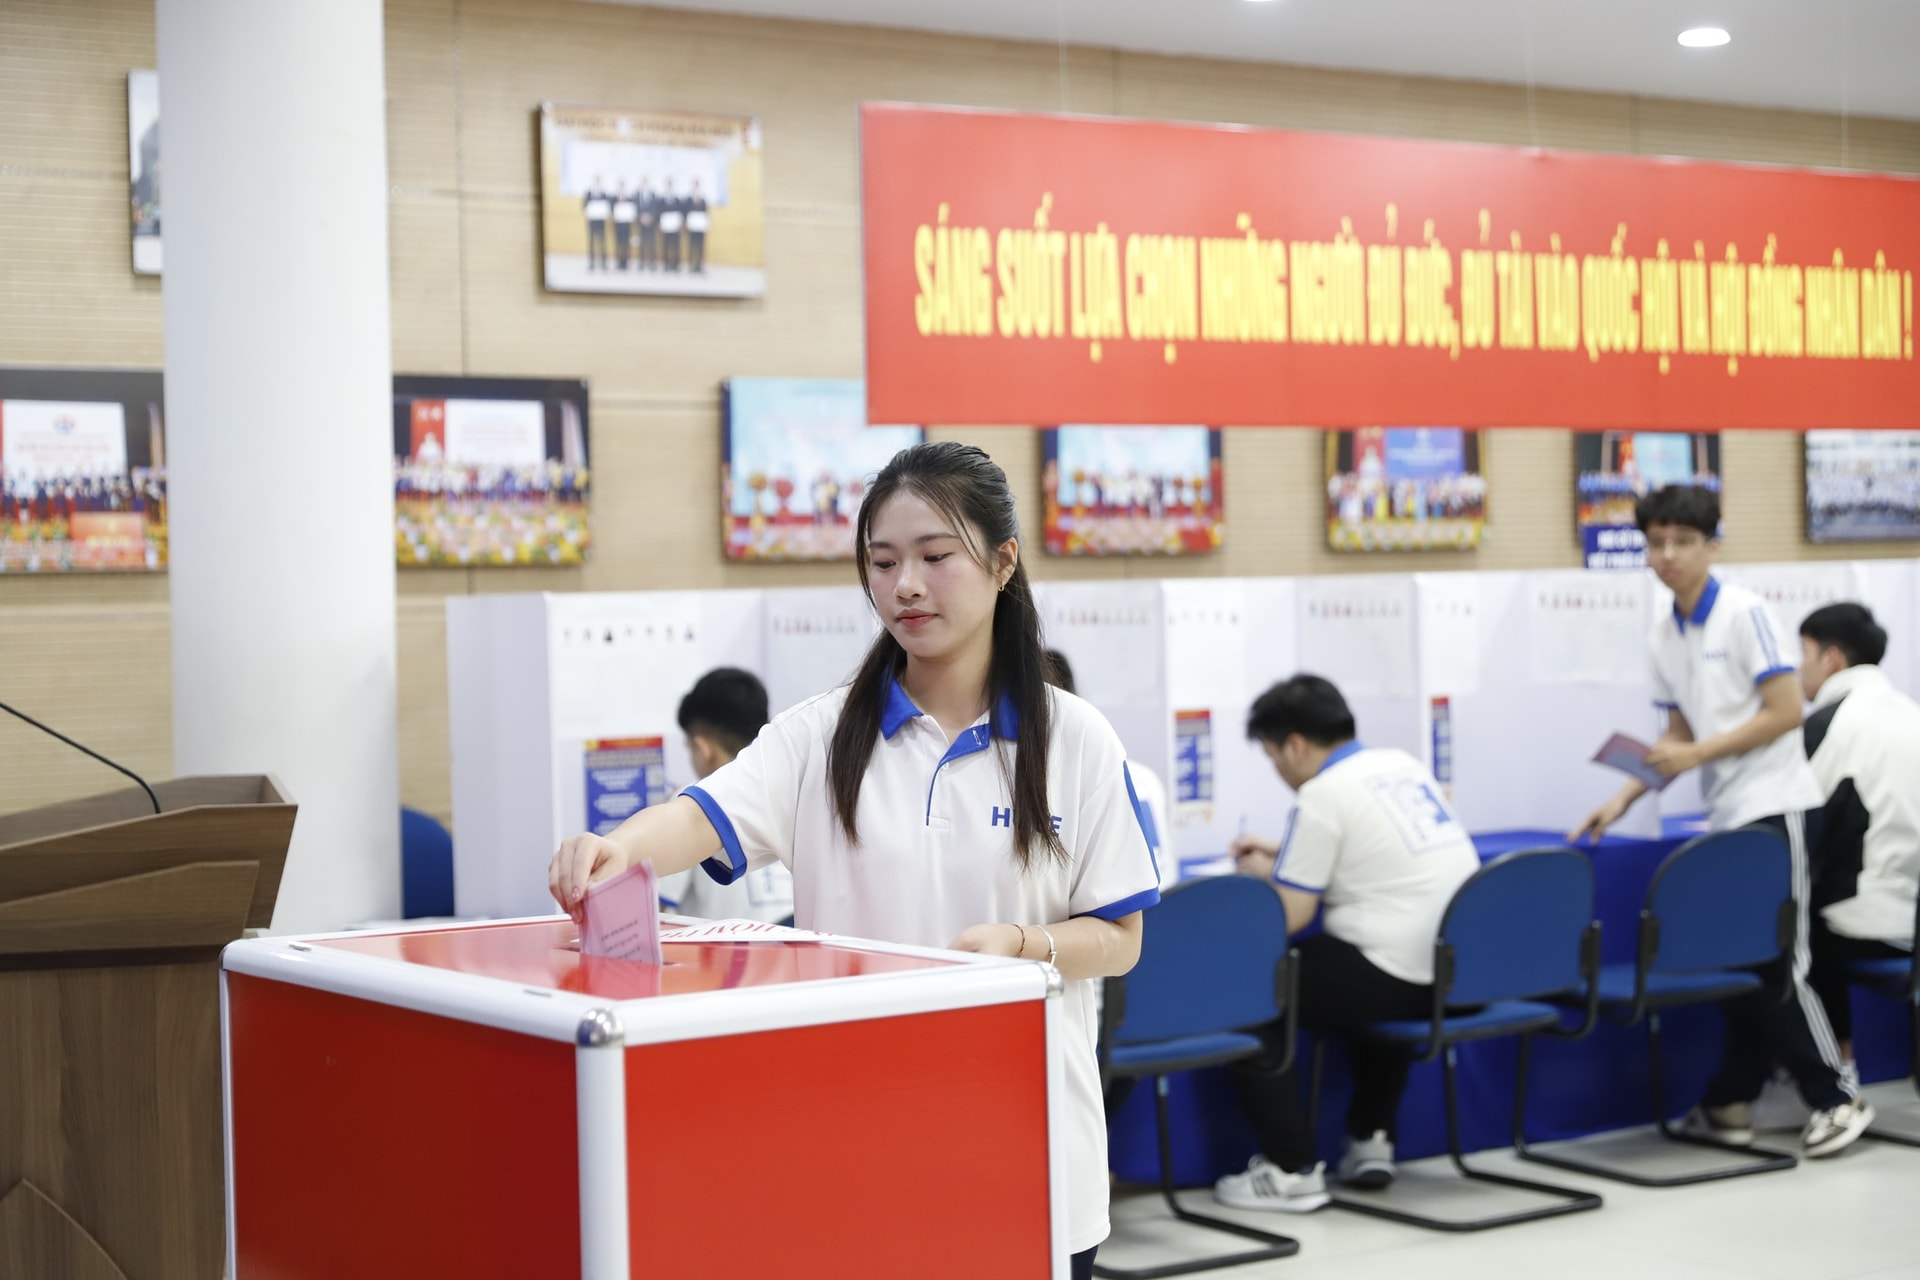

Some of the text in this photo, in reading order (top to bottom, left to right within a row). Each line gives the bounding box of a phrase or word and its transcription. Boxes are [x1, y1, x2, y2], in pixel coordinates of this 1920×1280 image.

[914, 203, 993, 337] SÁNG
[996, 191, 1068, 338] SUỐT
[1070, 221, 1124, 363] LỰA
[1125, 233, 1198, 364] CHỌN
[1200, 212, 1288, 343] NHỮNG
[1289, 216, 1366, 346] NGƯỜI
[1367, 202, 1403, 347] ĐỦ
[1461, 207, 1495, 349] ĐỦ
[1496, 229, 1534, 349] TÀI
[1581, 222, 1640, 363] QUỐC
[1641, 238, 1679, 375] HỘI
[1679, 239, 1710, 355] VÀ
[1710, 241, 1747, 377] HỘI
[1804, 247, 1859, 359] NHÂN
[991, 806, 1062, 838] HE
